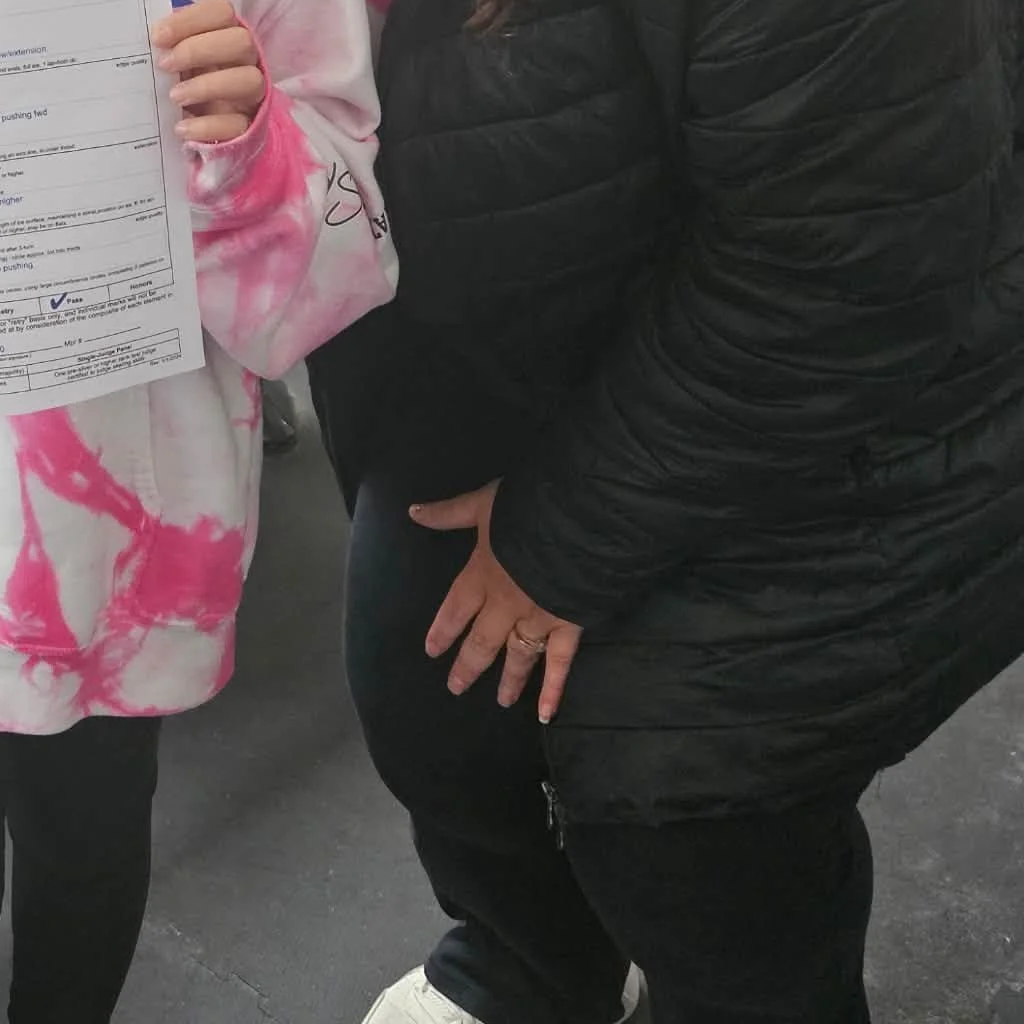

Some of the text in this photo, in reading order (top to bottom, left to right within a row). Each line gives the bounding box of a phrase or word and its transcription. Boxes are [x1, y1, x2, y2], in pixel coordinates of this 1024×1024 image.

[1, 110, 32, 122] pushing
[33, 108, 47, 116] fwd
[3, 262, 33, 272] pushing
[26, 318, 67, 330] consideration
